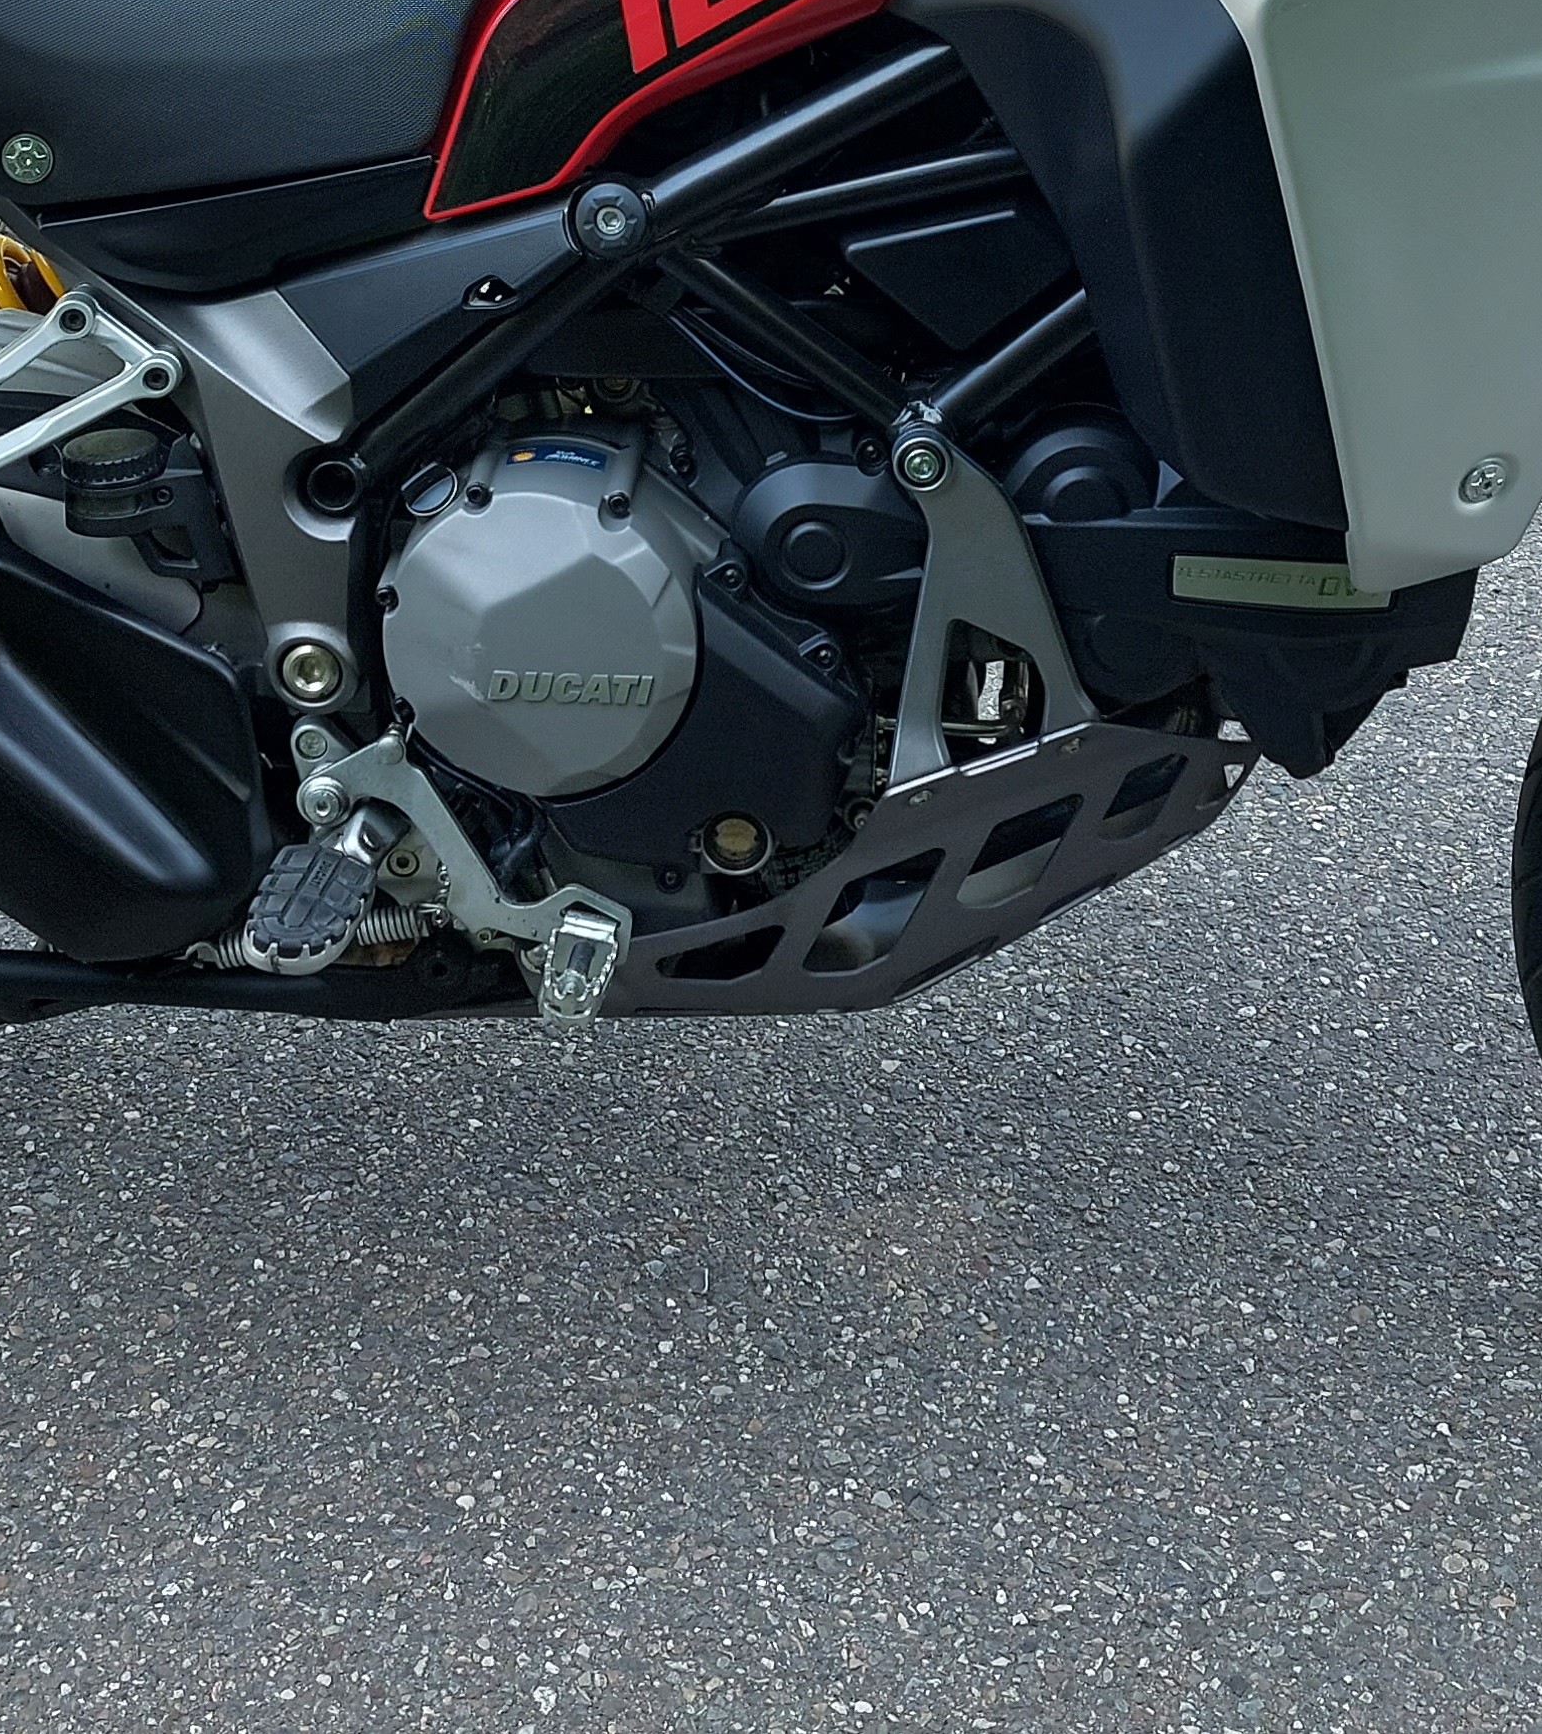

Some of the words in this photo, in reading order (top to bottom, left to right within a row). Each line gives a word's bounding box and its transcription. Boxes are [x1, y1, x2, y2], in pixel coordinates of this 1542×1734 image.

[1177, 567, 1316, 585] TESTASTRETTA
[1318, 576, 1376, 598] DV
[487, 669, 654, 705] DUCATI
